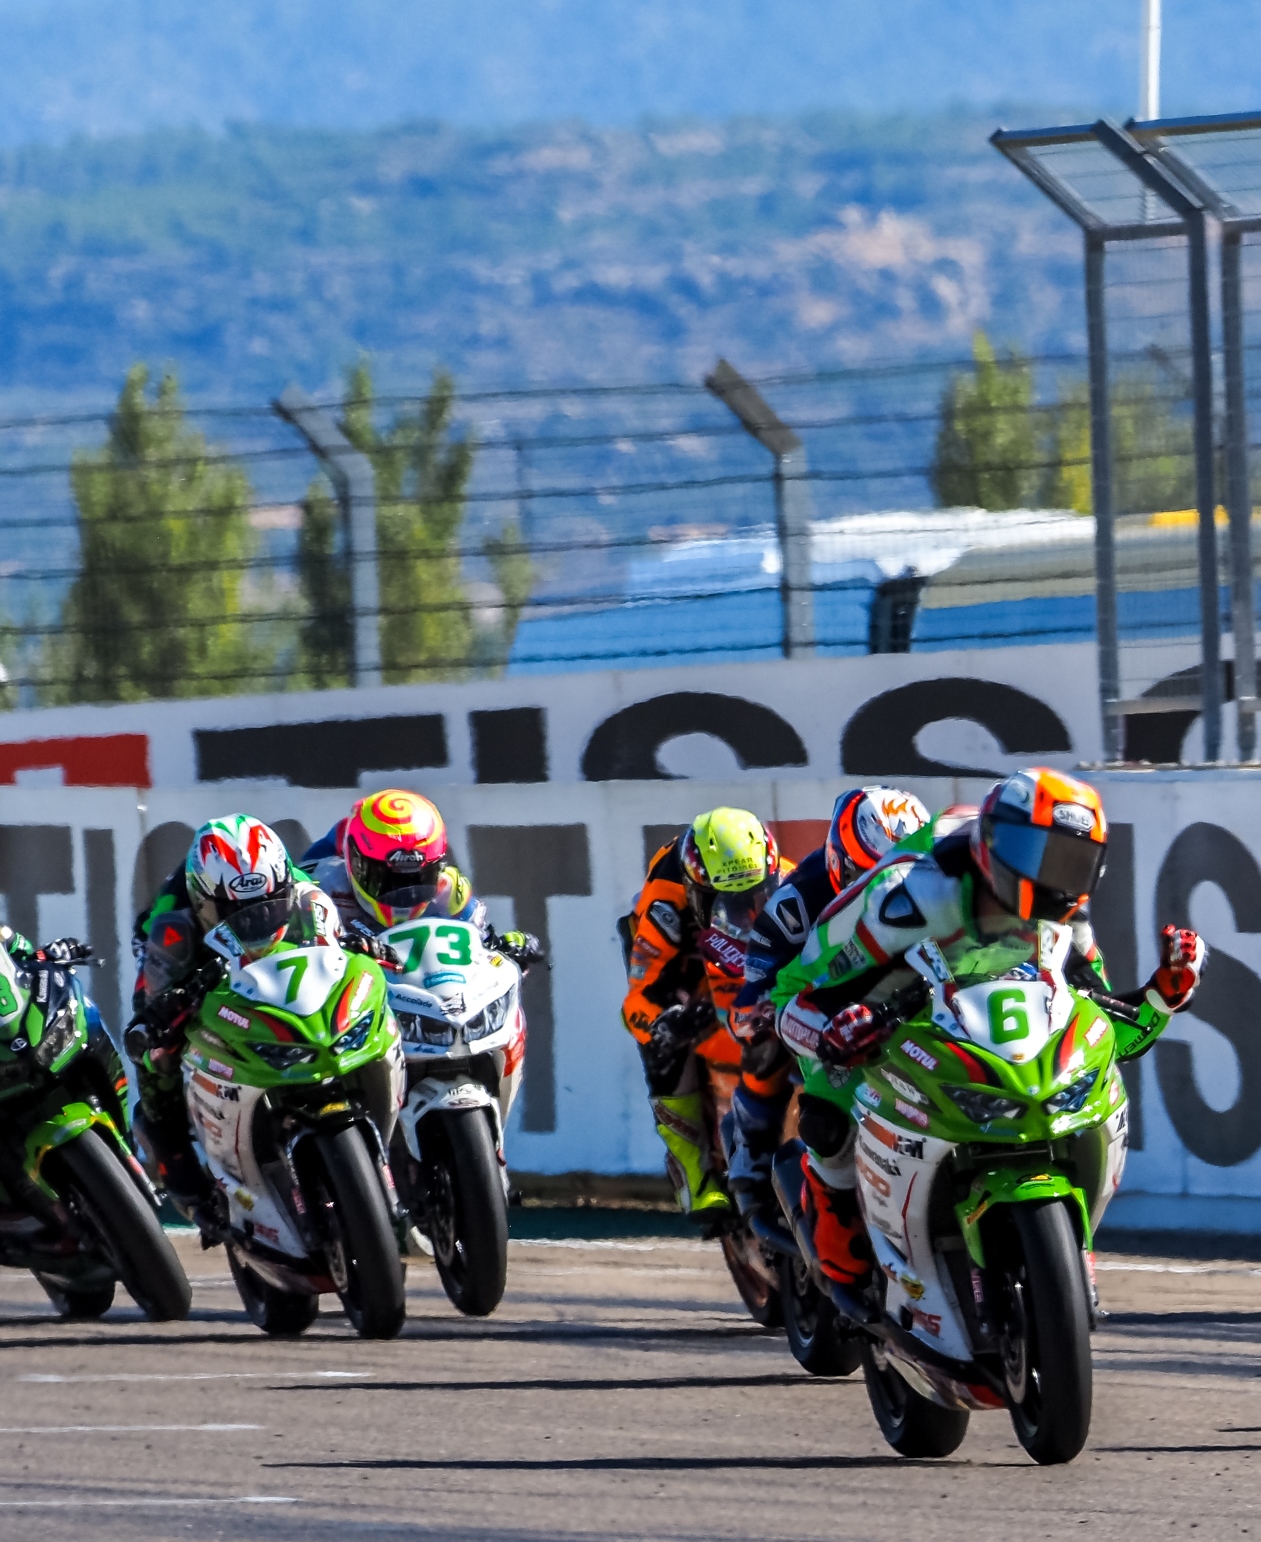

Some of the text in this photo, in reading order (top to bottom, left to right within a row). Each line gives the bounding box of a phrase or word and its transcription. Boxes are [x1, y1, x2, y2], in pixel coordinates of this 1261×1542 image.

[388, 850, 424, 863] Airoh
[231, 873, 266, 889] Arai
[388, 925, 473, 972] 73
[276, 955, 309, 1005] 7
[394, 992, 433, 1009] Accolade
[218, 1005, 250, 1030] MOTUL
[987, 987, 1030, 1045] 6
[900, 1040, 938, 1071] MOTUL
